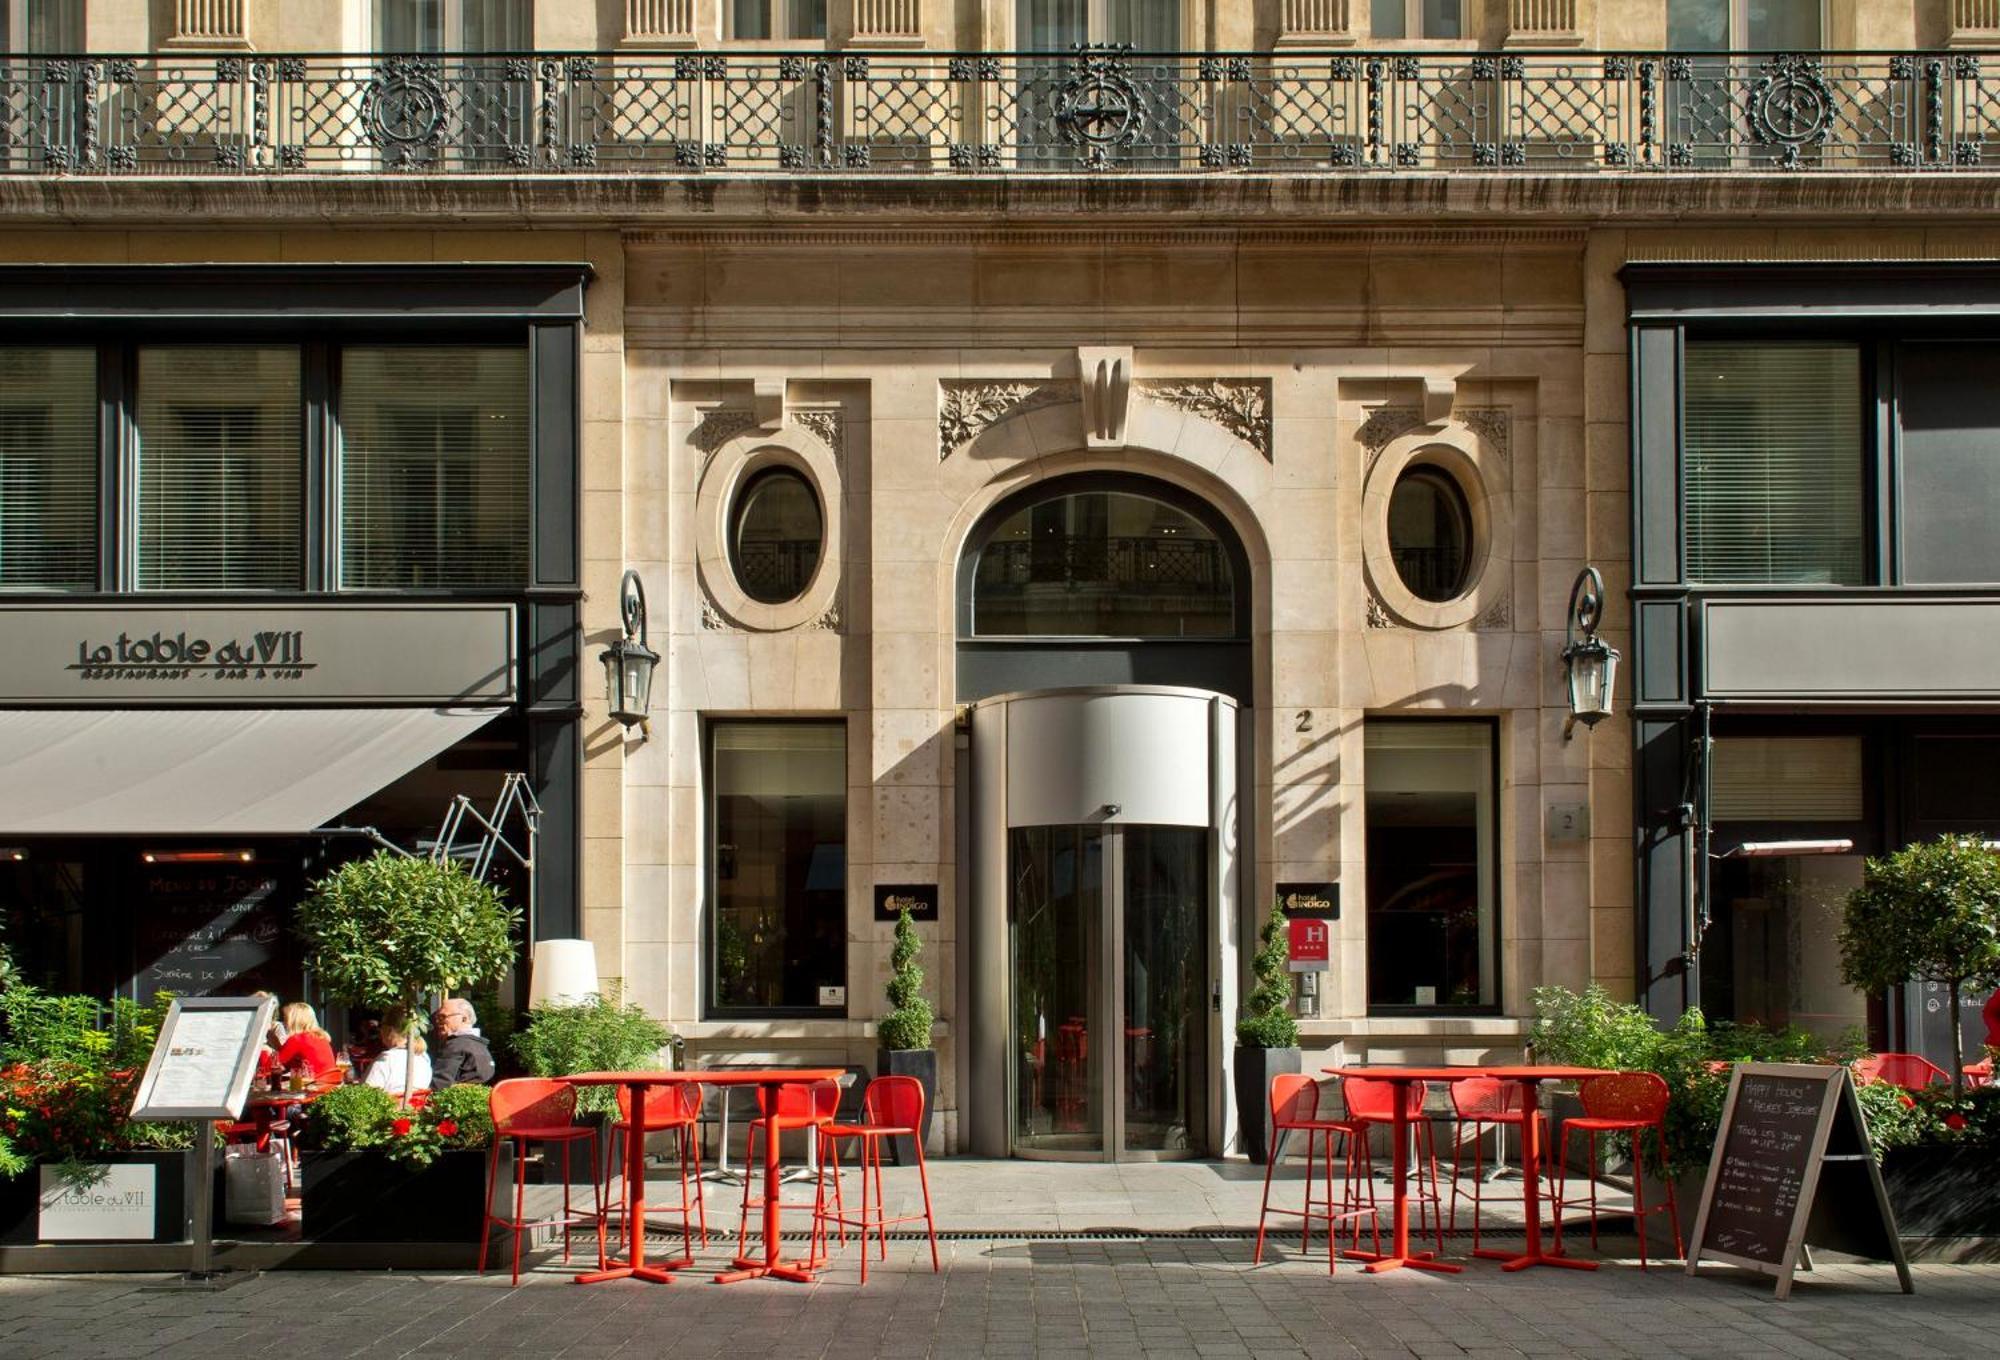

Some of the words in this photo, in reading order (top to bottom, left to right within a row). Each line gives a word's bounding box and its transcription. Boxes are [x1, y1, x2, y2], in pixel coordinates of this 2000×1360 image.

[79, 639, 112, 664] La
[115, 631, 211, 664] table
[215, 639, 254, 664] du
[254, 631, 303, 664] VII
[80, 668, 190, 681] RESTAURANT
[214, 668, 248, 681] BAR
[272, 668, 304, 681] VIN
[1295, 709, 1313, 733] 2
[1562, 813, 1574, 830] 2
[1298, 900, 1331, 909] INDIGO
[1306, 926, 1324, 942] H
